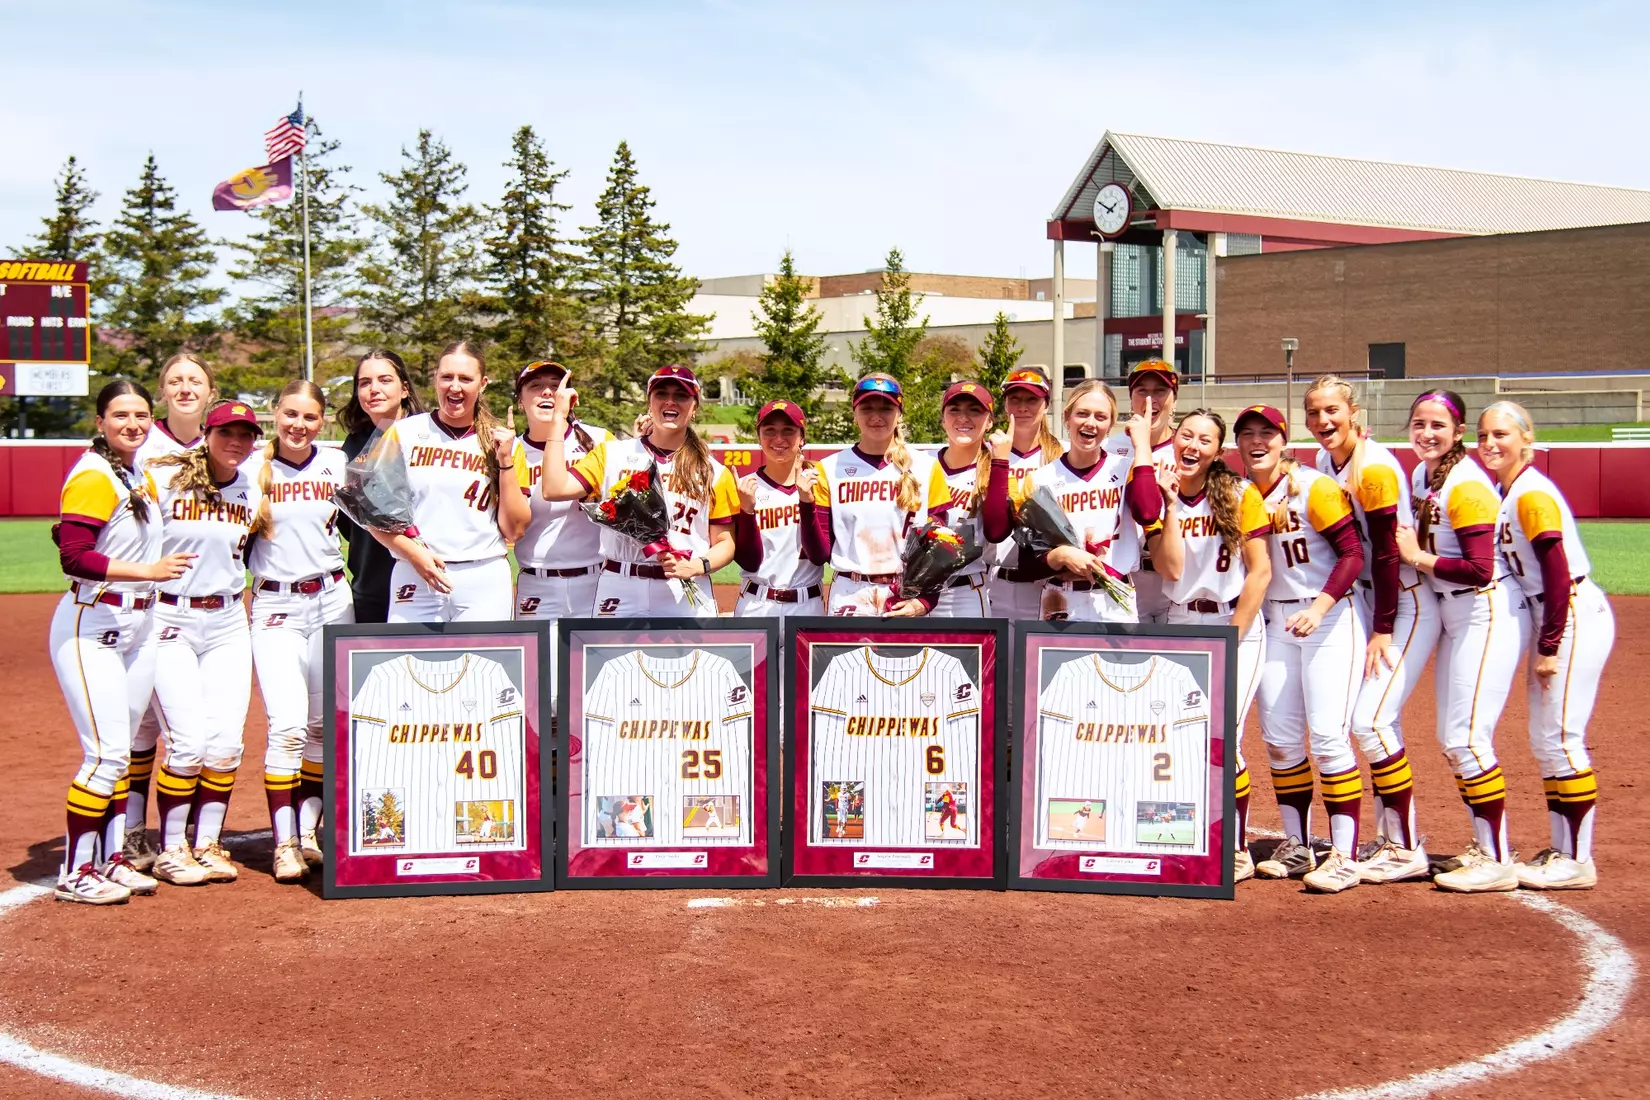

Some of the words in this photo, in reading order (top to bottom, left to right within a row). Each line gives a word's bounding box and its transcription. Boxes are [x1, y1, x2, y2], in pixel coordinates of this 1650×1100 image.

[0, 262, 76, 281] SOFTBALL
[1136, 338, 1152, 346] STUDENT
[410, 446, 488, 475] CHIPPEWA
[724, 450, 752, 466] 220
[464, 480, 491, 512] 40
[838, 480, 901, 504] CHIPPEW
[172, 498, 253, 527] CHIPPEWAS
[1216, 543, 1231, 573] 8
[1281, 537, 1310, 568] 10
[390, 723, 483, 743] CHIPPEWAS
[619, 720, 711, 740] CHIPPEWAS
[847, 716, 939, 737] CHIPPEWAS
[1075, 722, 1167, 743] CHIPPEWAS
[455, 749, 497, 780] 40
[681, 749, 722, 780] 25
[926, 744, 945, 775] 6
[1153, 752, 1172, 782] 2
